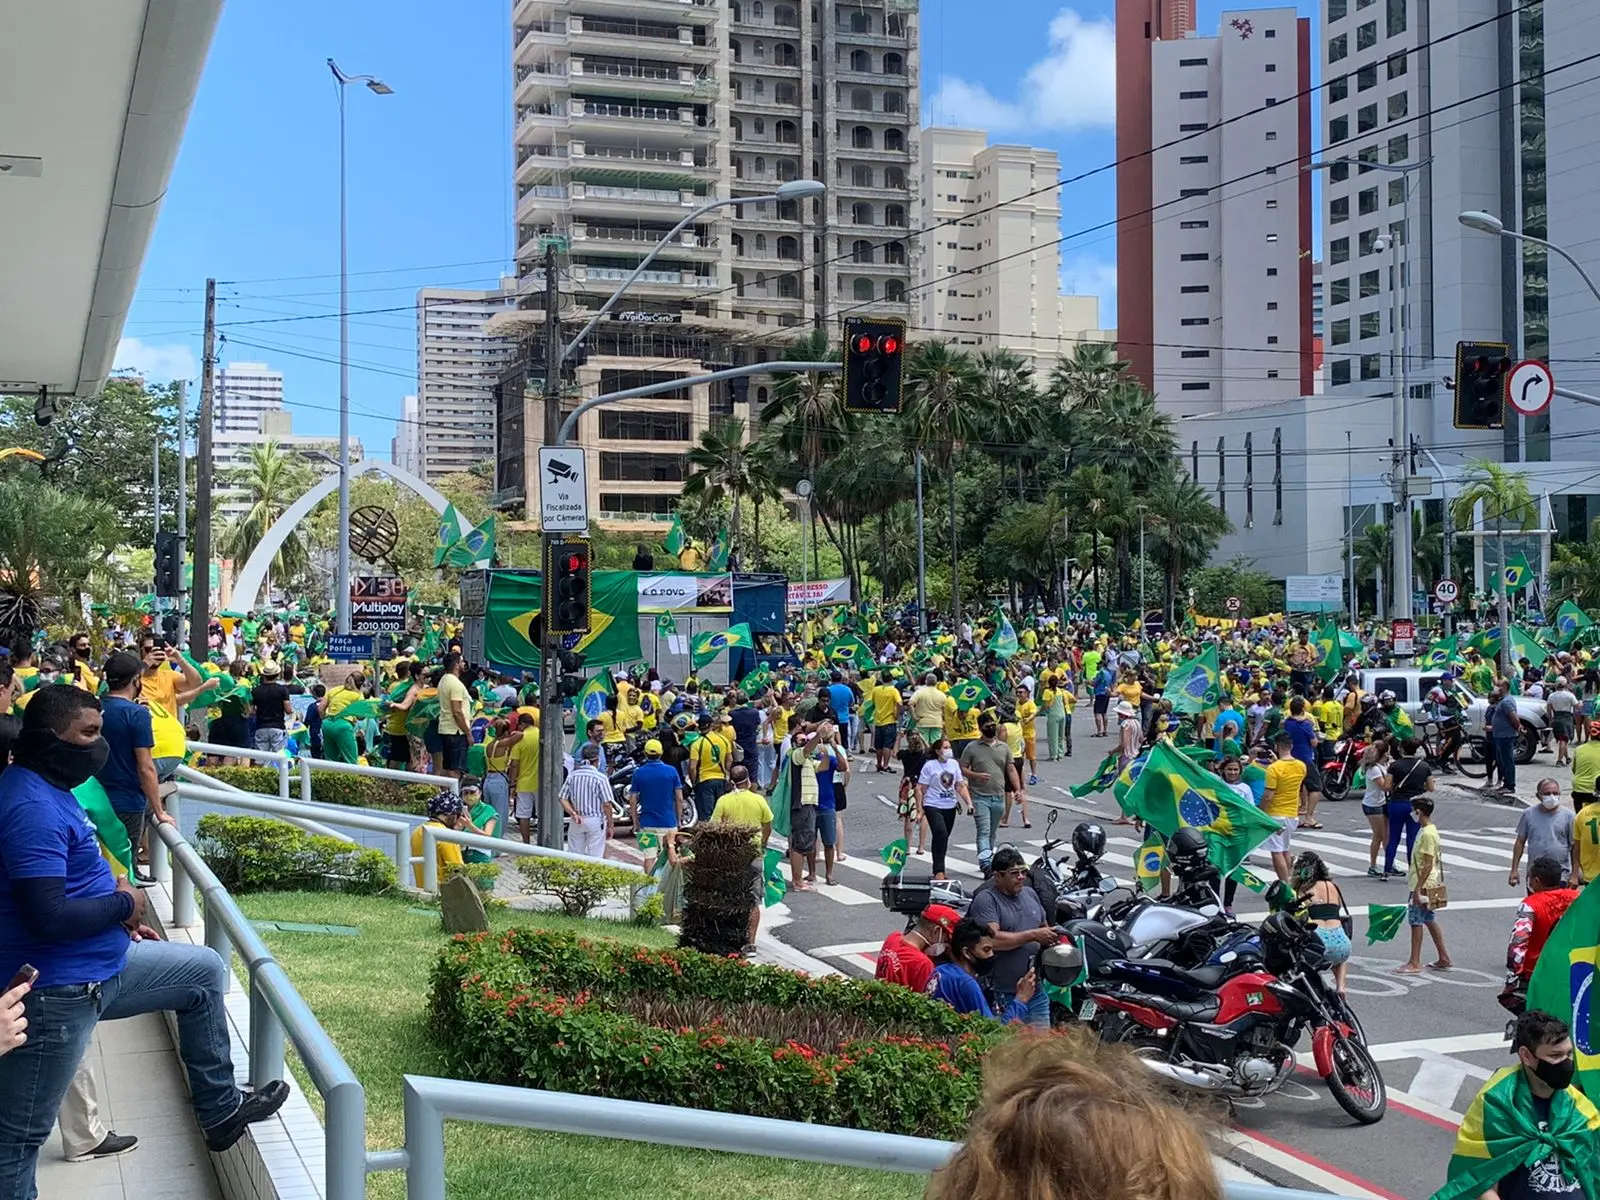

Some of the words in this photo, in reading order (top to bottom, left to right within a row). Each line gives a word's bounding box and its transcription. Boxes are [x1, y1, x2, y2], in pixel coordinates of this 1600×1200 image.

[546, 503, 582, 511] Fiscalizada
[1439, 584, 1455, 593] 40
[353, 601, 404, 615] Multiplay
[329, 637, 352, 646] Praça
[329, 645, 365, 653] Portugal
